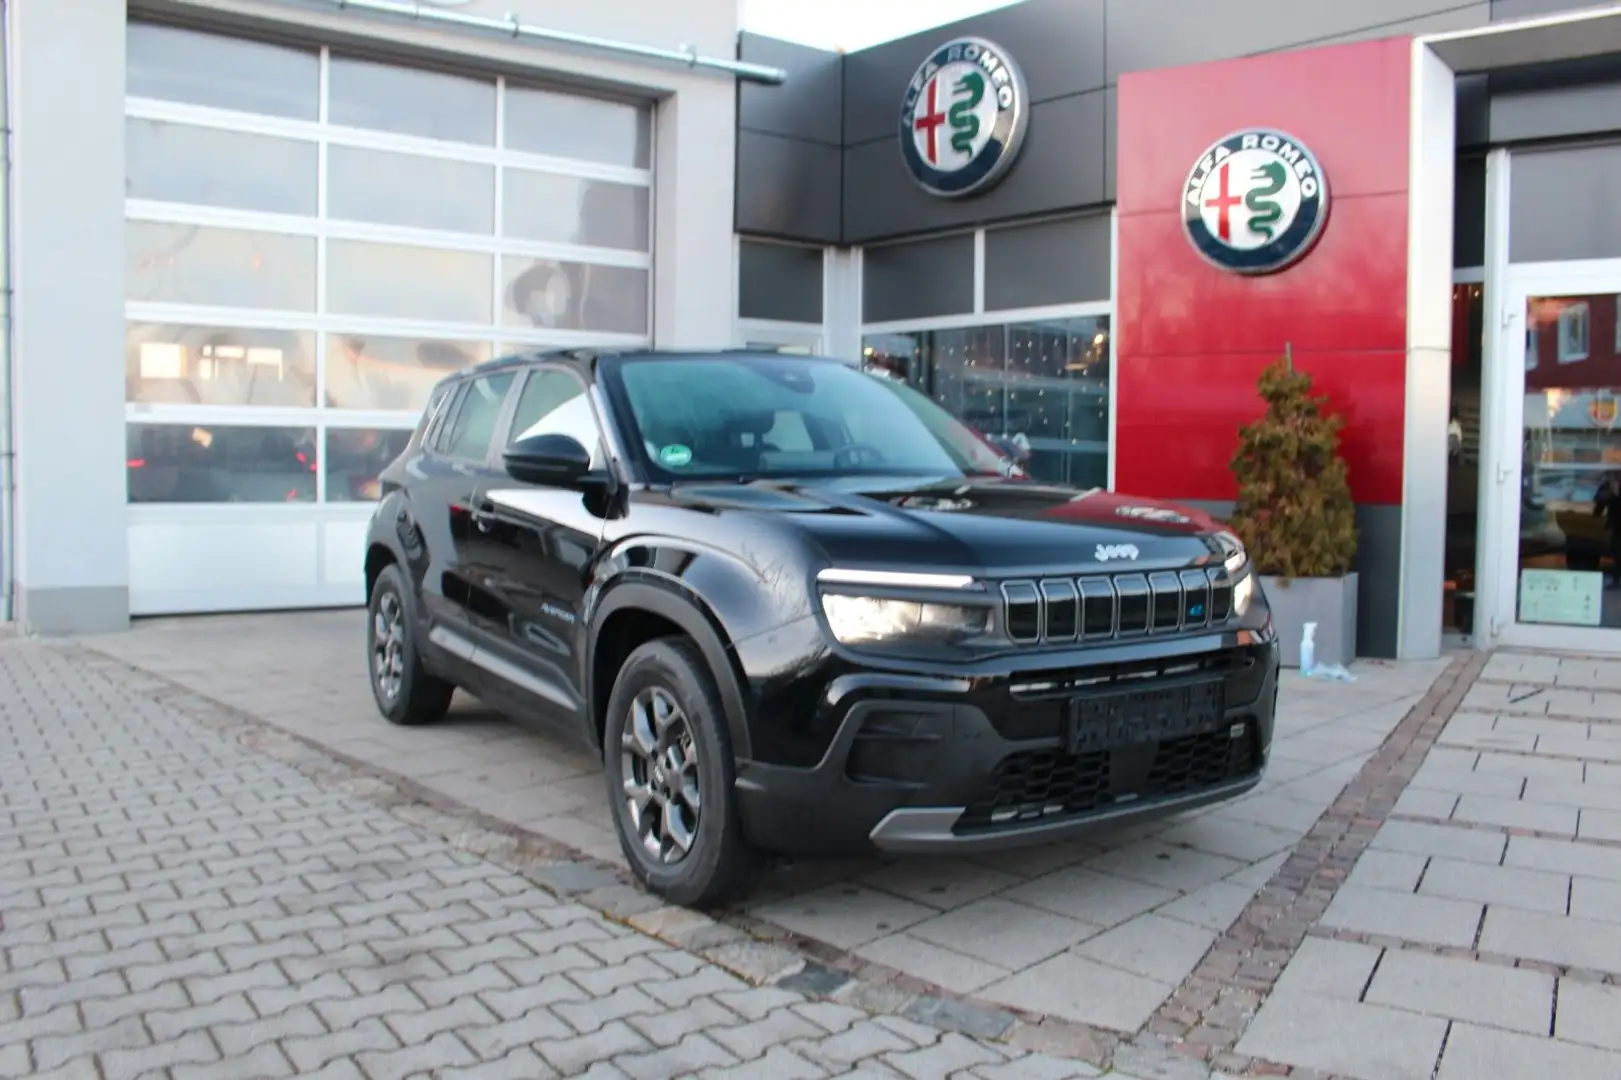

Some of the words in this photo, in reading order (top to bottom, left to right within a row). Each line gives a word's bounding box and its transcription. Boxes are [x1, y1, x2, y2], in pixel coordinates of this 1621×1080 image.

[902, 61, 939, 128] ALFA
[948, 44, 1013, 109] ROMEO
[1187, 145, 1231, 207] ALFA
[1242, 133, 1318, 198] ROMEO
